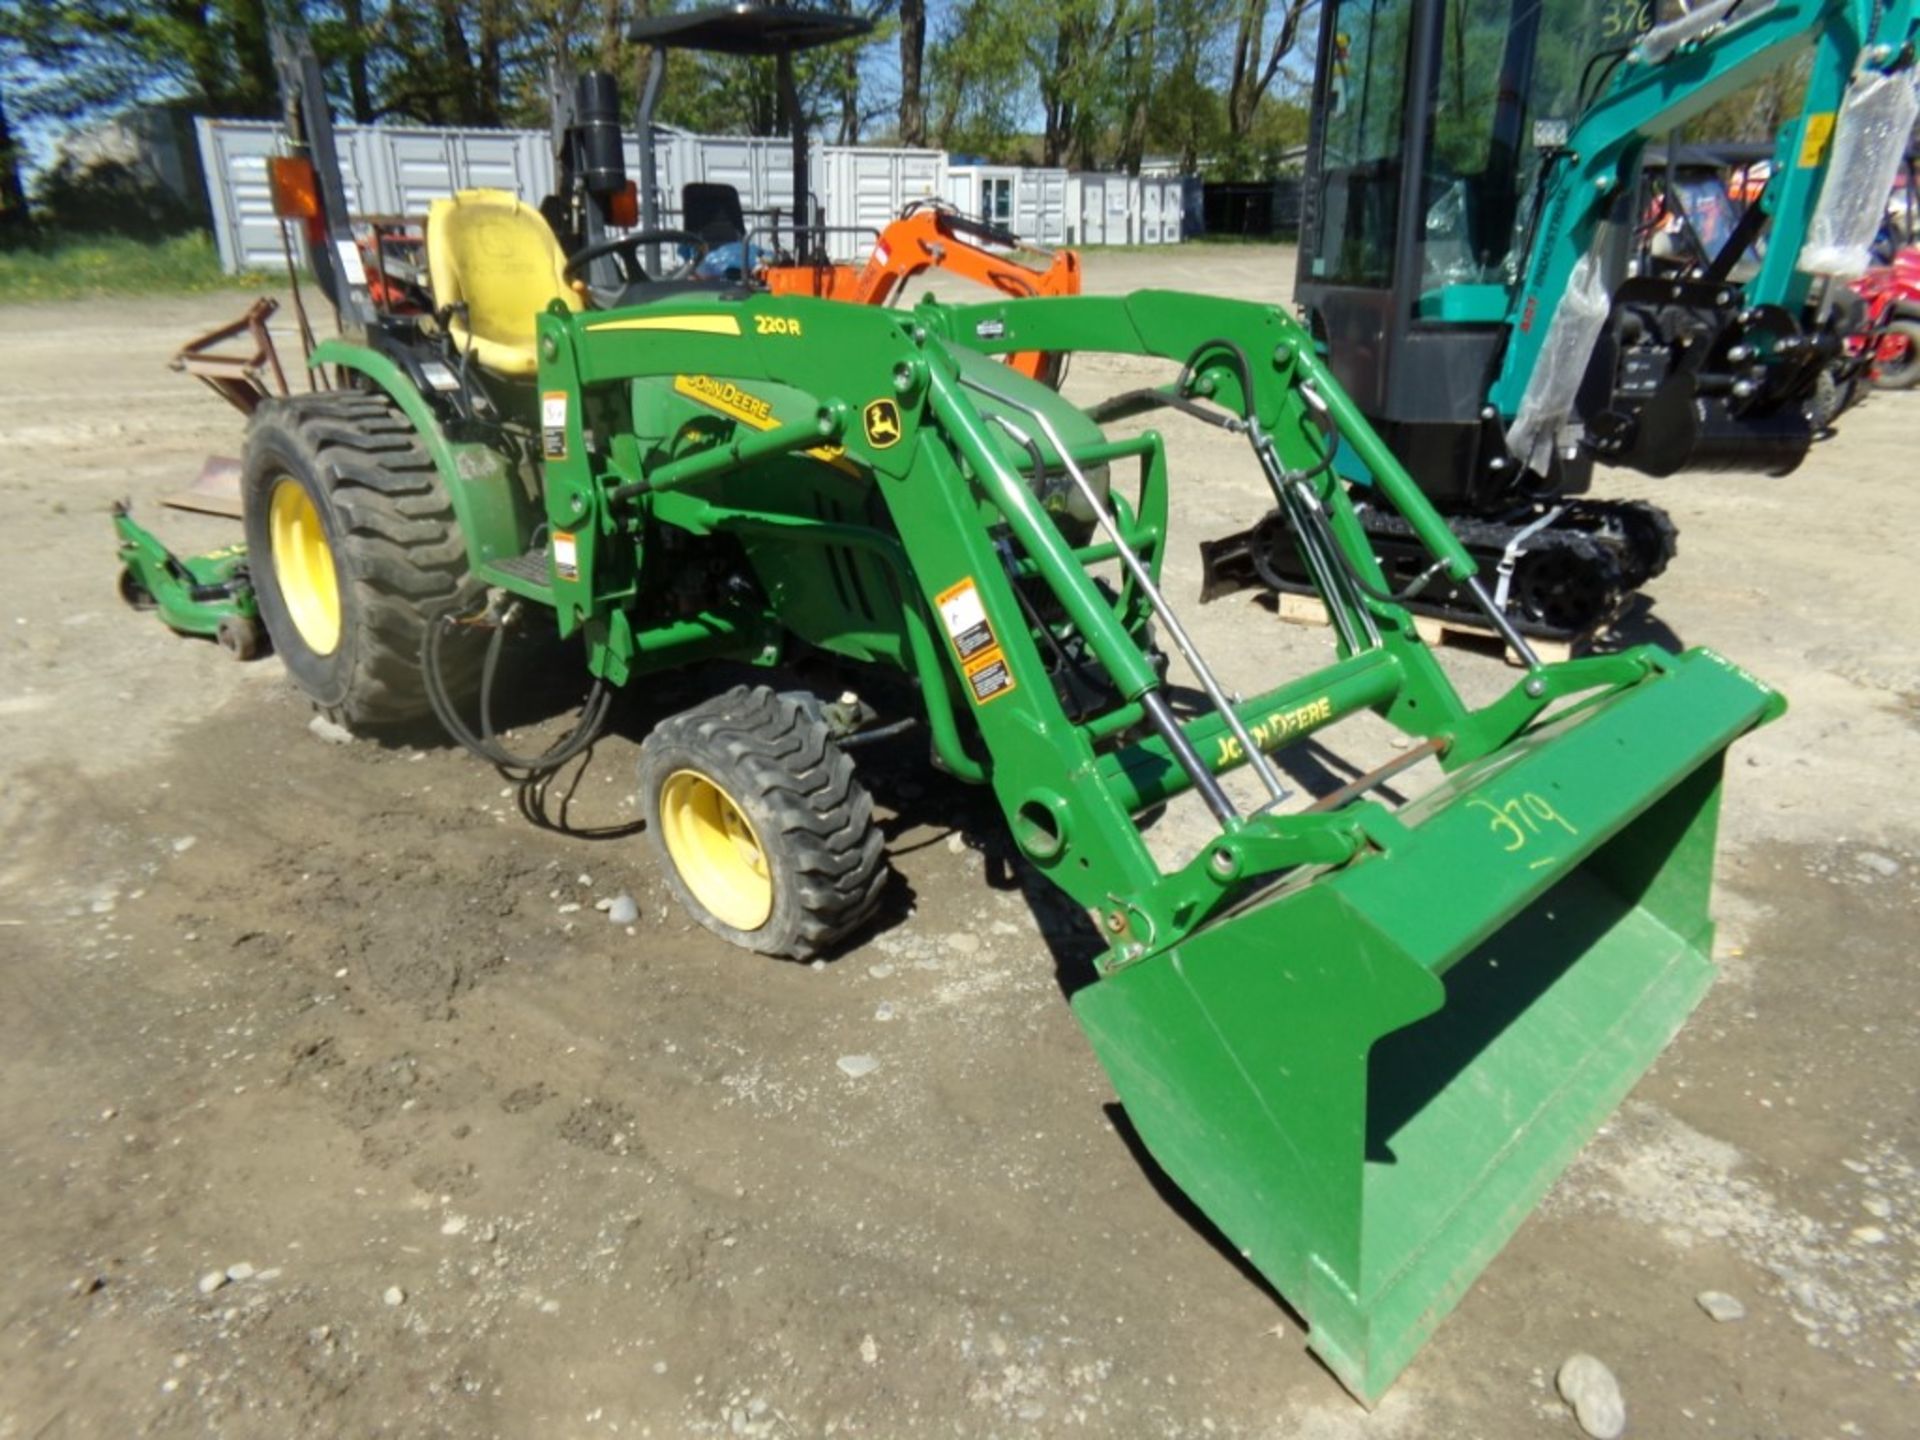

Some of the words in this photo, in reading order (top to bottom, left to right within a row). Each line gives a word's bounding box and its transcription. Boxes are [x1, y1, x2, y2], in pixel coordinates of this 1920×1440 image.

[1602, 1, 1651, 37] 376
[722, 383, 772, 419] DEERE
[1218, 723, 1269, 766] JON
[1268, 697, 1331, 738] DEERE
